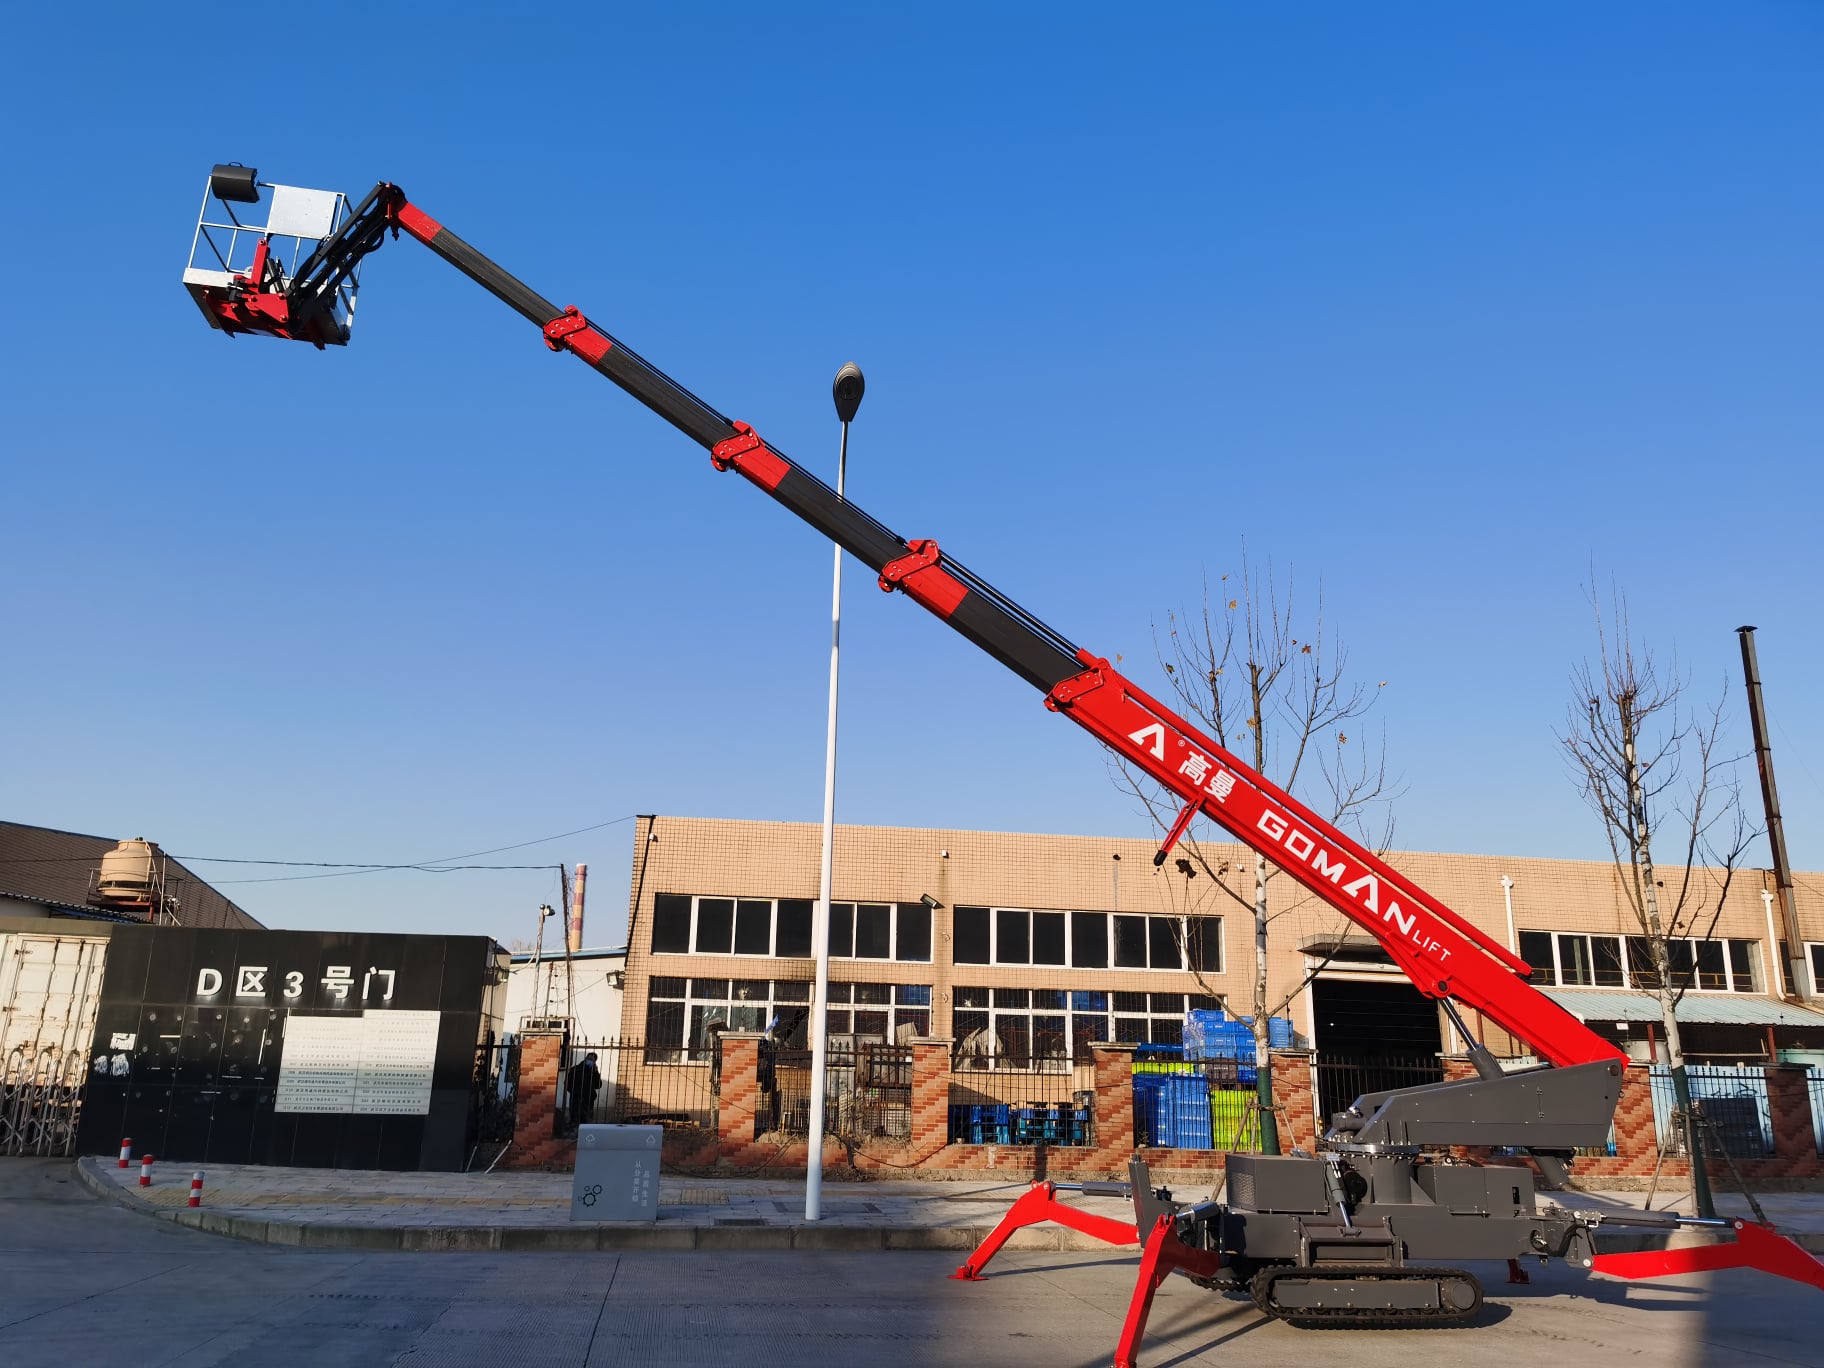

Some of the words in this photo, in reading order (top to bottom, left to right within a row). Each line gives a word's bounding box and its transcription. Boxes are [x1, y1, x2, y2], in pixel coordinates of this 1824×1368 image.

[1178, 750, 1237, 804] 高曼
[196, 965, 396, 1000] D区3号门
